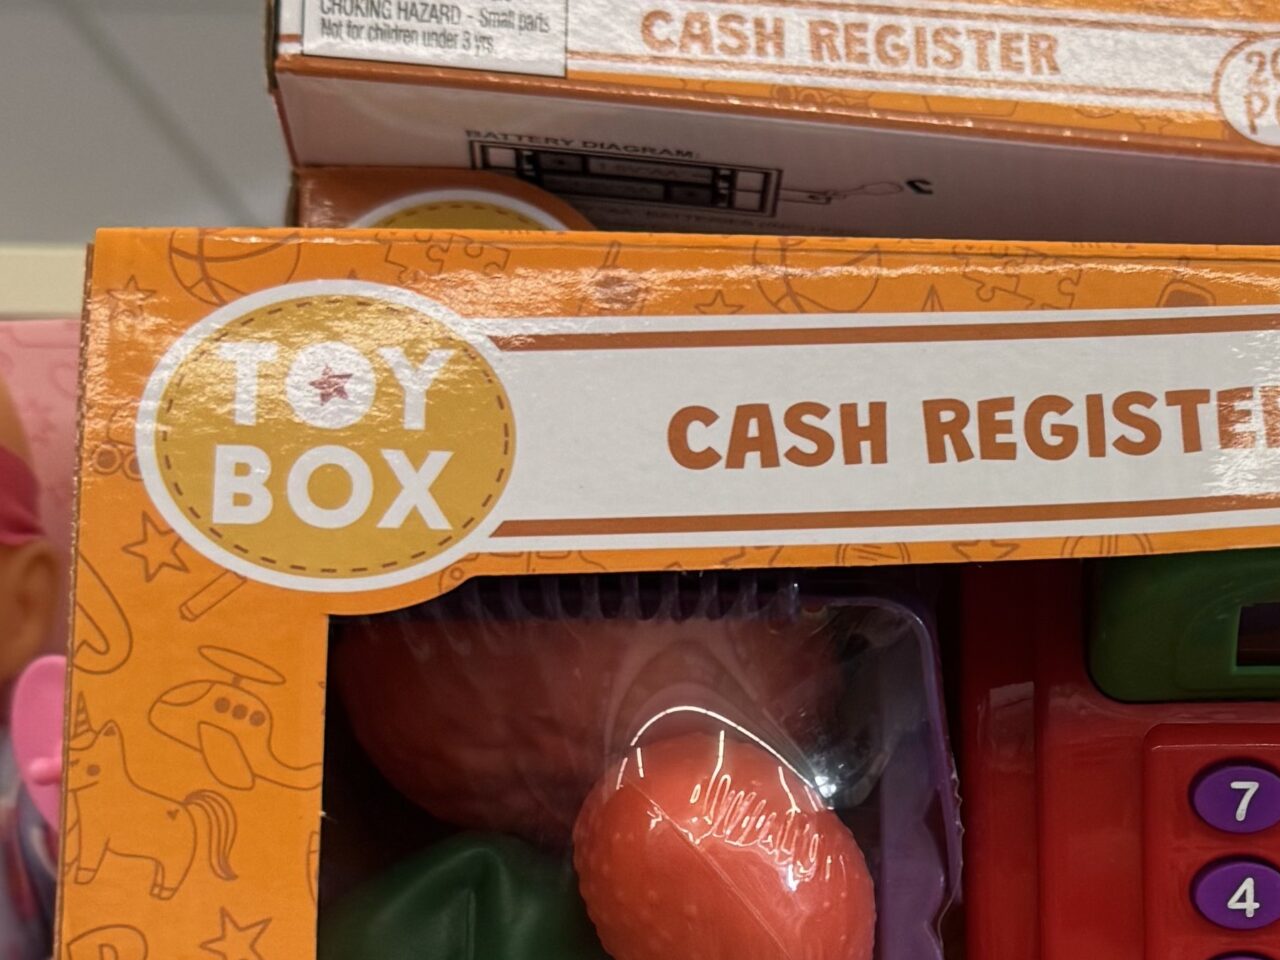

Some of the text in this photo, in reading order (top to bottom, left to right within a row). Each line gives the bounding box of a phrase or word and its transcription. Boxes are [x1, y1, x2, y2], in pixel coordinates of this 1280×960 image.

[321, 18, 342, 40] Not
[347, 20, 363, 38] for
[367, 23, 418, 46] children
[422, 30, 459, 48] under
[398, 0, 461, 25] HAZARD
[640, 10, 1061, 76] CASH REGISTER
[465, 129, 573, 147] BATTERY
[217, 341, 457, 430] TOY
[667, 401, 888, 470] CASH
[212, 444, 454, 531] BOX
[1229, 781, 1260, 822] 7
[1227, 877, 1260, 918] 4
